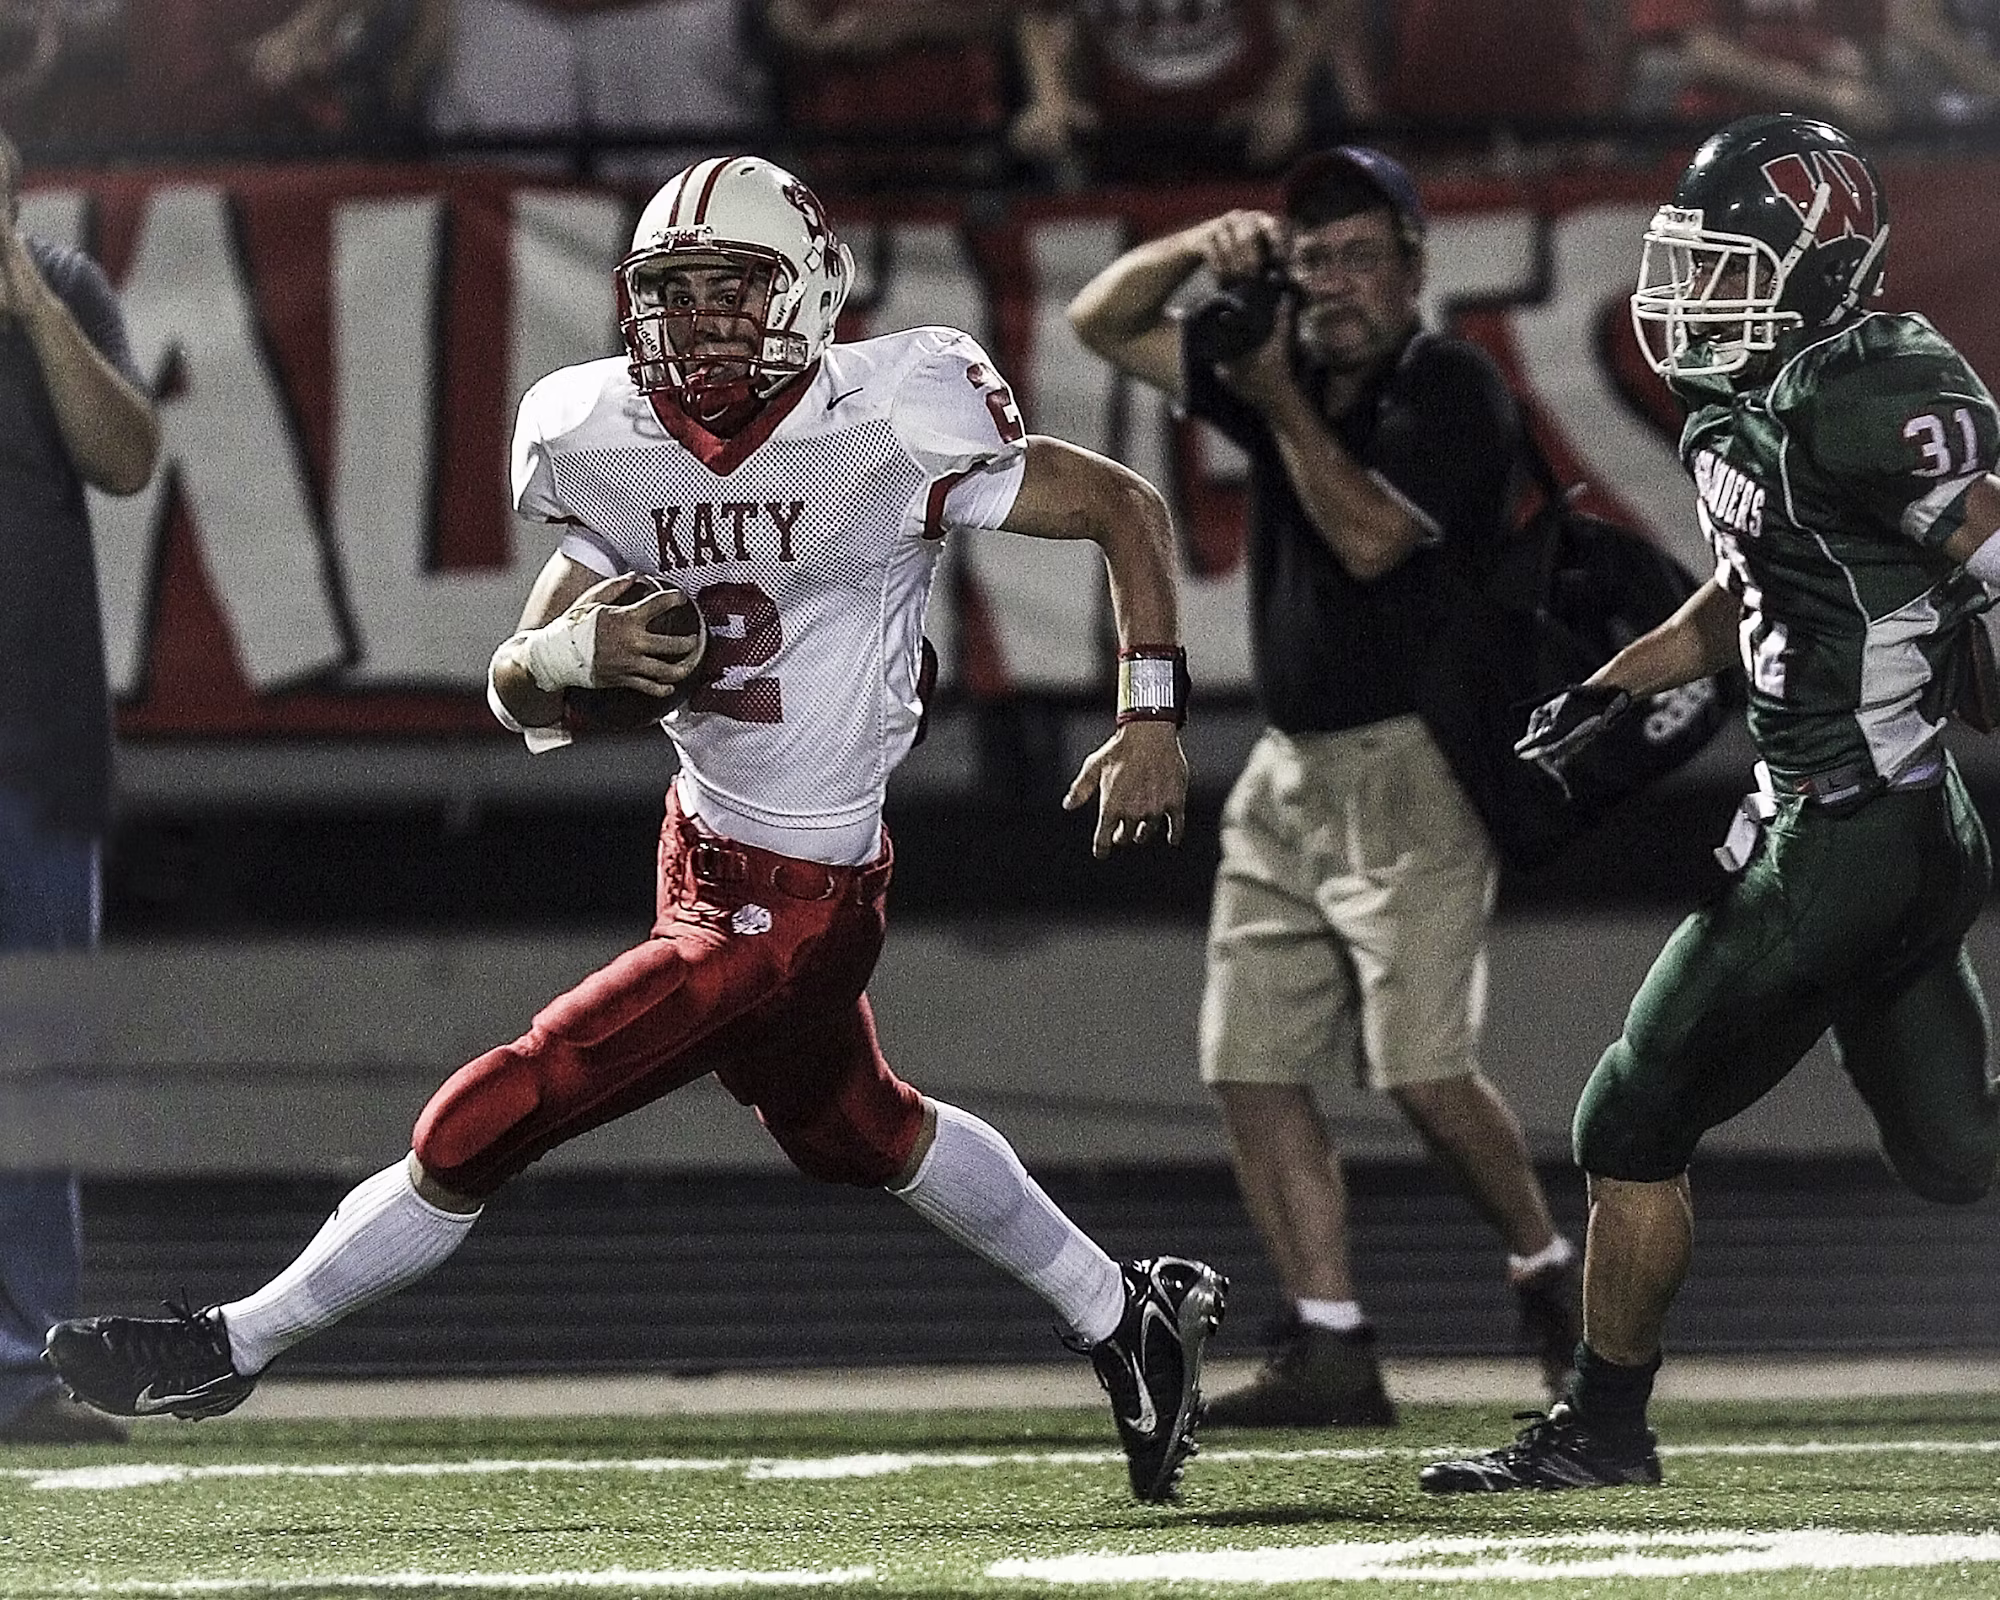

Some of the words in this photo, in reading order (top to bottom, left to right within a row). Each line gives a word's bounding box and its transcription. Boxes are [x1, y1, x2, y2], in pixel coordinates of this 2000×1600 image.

[1760, 149, 1880, 249] W
[966, 362, 1024, 445] 2
[1902, 408, 1979, 477] 31
[650, 500, 806, 572] KATY
[688, 581, 784, 724] 2
